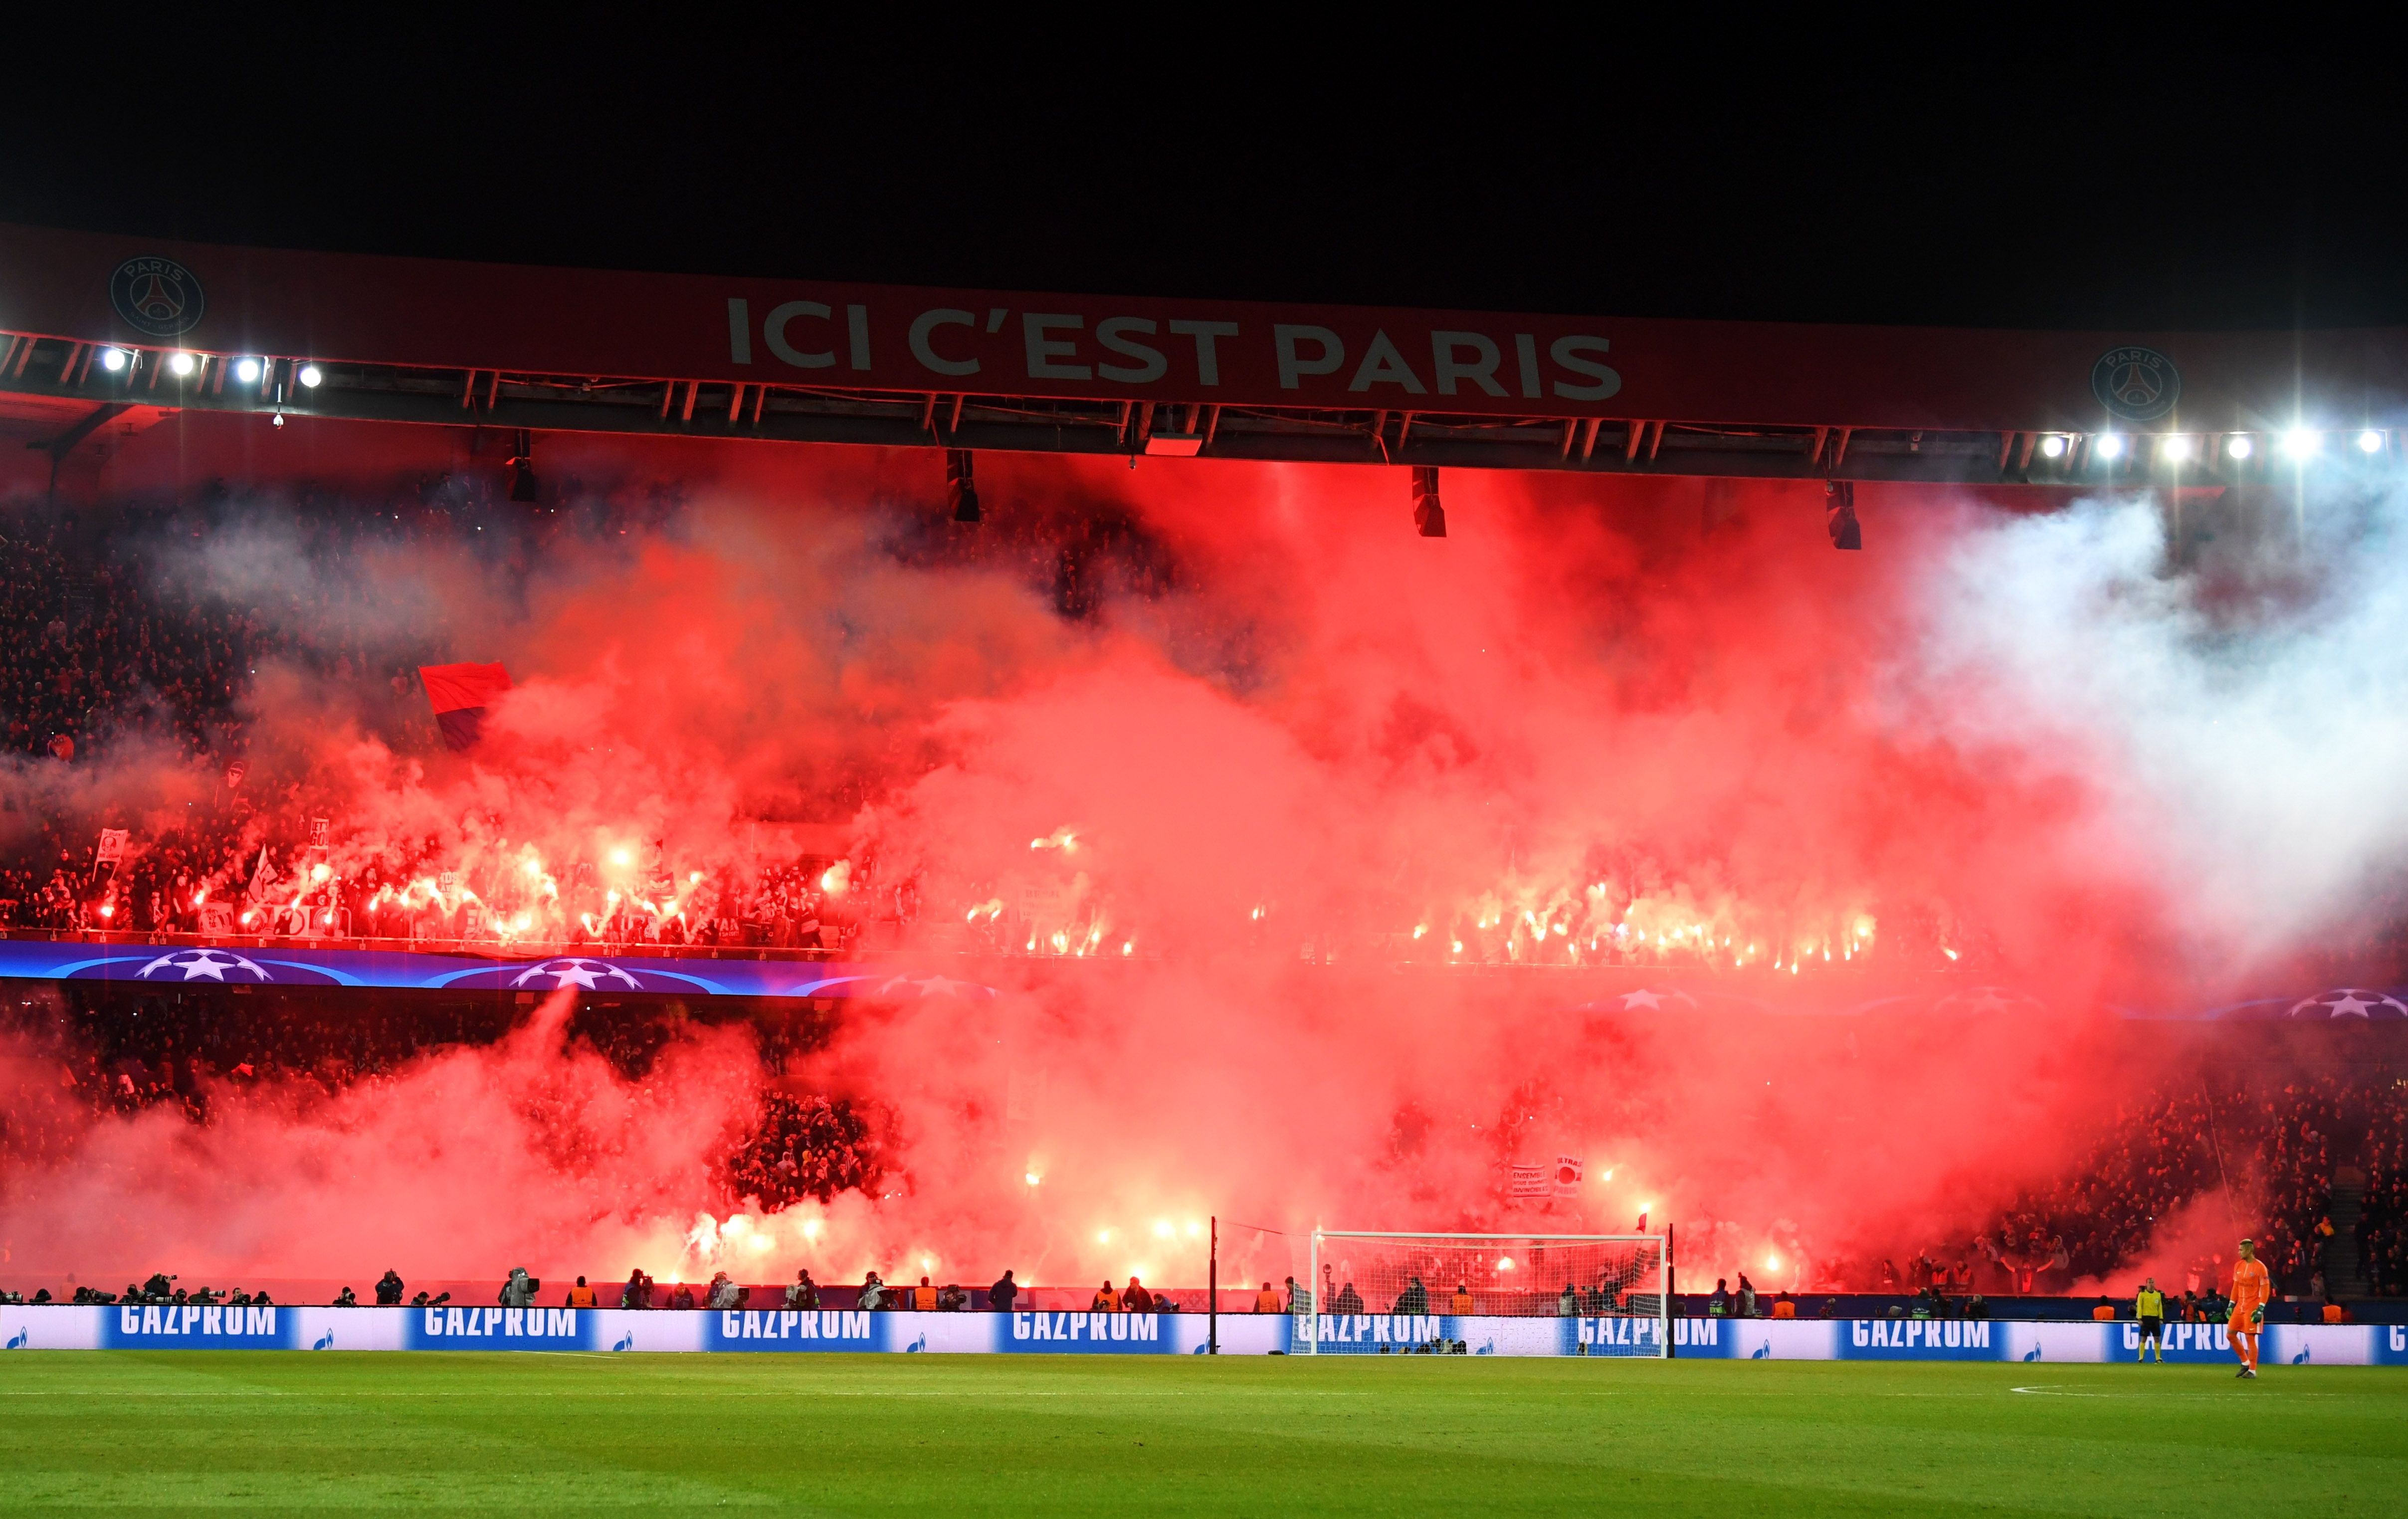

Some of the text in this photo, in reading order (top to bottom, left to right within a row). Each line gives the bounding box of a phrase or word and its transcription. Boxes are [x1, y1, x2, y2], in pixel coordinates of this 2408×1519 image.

[124, 261, 184, 281] PARIS
[728, 298, 1621, 400] ICI C'EST PARIS
[2105, 351, 2162, 369] PARIS
[1557, 1157, 1583, 1167] ULTRAS
[1553, 1185, 1578, 1194] PARIS
[121, 1306, 275, 1335] GAZPROM
[425, 1308, 576, 1336] GAZPROM
[722, 1311, 870, 1338] GAZPROM
[1013, 1312, 1158, 1340] GAZPROM
[1852, 1320, 1989, 1347] GAZPROM
